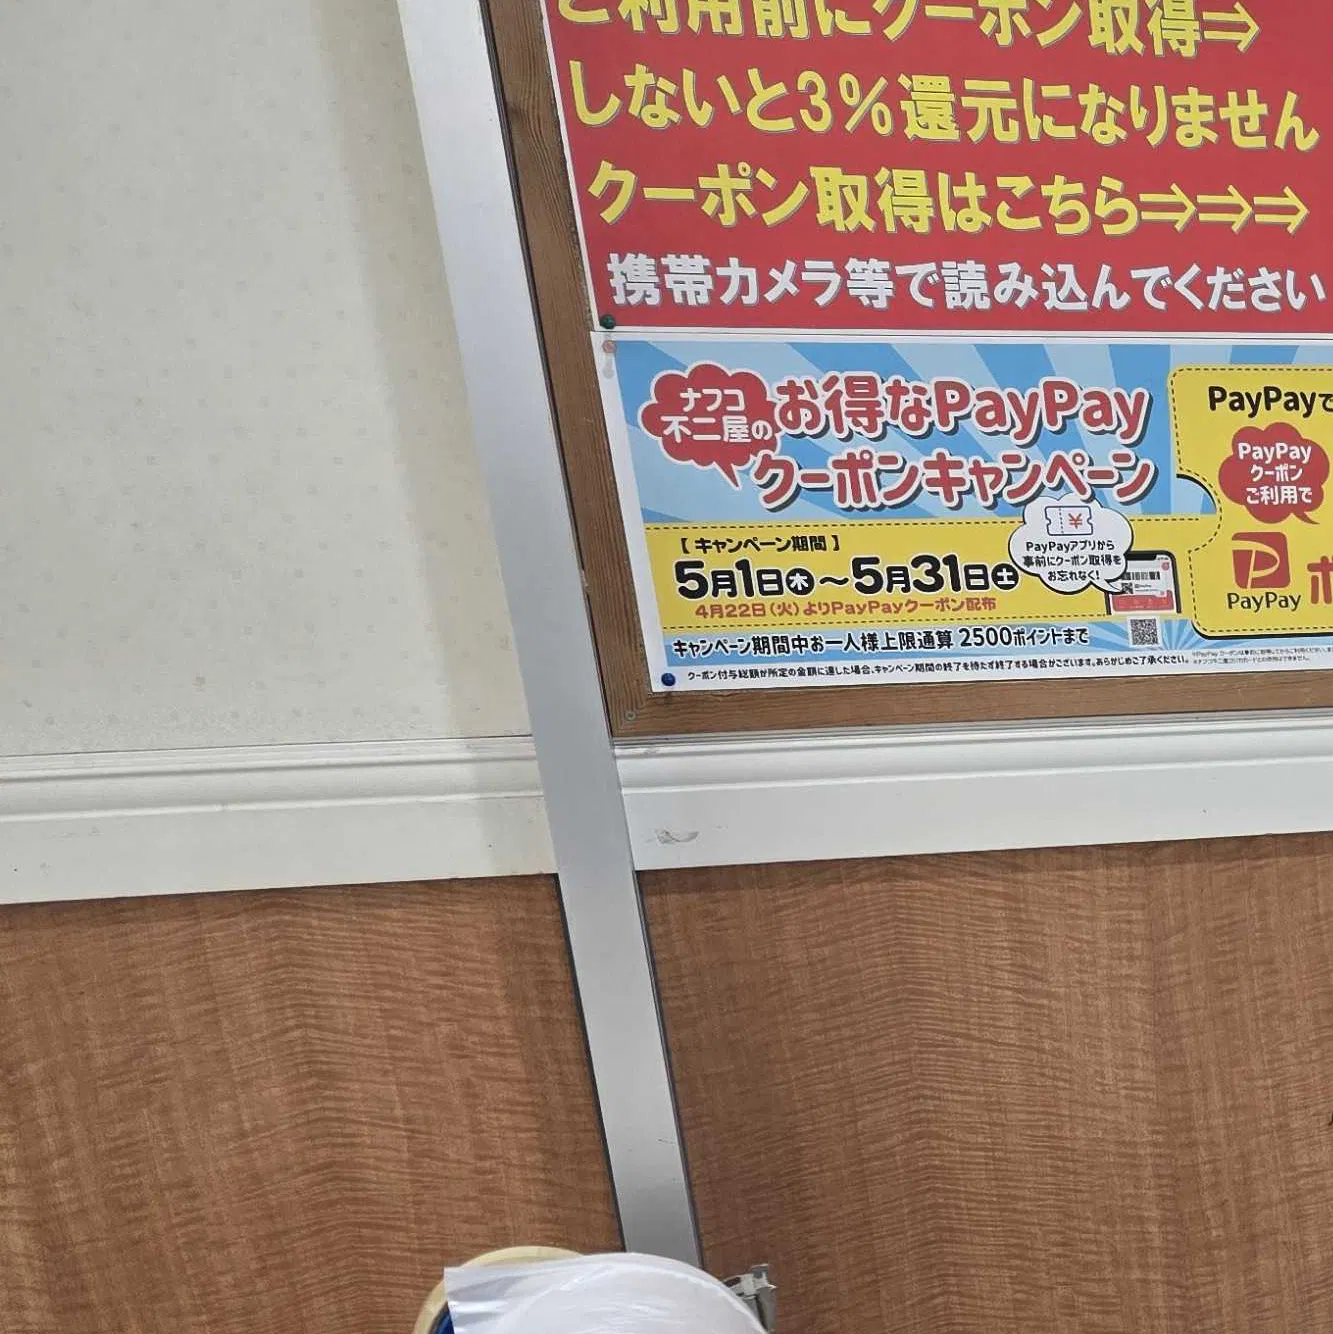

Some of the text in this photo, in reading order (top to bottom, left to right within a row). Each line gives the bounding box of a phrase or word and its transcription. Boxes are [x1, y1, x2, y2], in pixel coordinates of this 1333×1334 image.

[569, 60, 1320, 152] しないと3%還元になりません
[588, 160, 1141, 236] クーポン取得はこちら
[607, 252, 1326, 313] 携帯カメラ等で読み込んでください
[679, 388, 743, 411] ナフコ
[776, 374, 1150, 447] お得なPayPay
[1208, 385, 1333, 418] PayPayで
[662, 414, 770, 444] 不二屋の
[1238, 442, 1312, 464] PayPay
[755, 449, 1156, 508] クーポンキャンペーン
[1250, 465, 1303, 482] クーポン
[1246, 485, 1312, 506] ご利用で
[1026, 540, 1115, 553] PayPayアプリから
[1023, 554, 1122, 567] 事前にクーポン取得を
[1048, 570, 1100, 582] お忘れなく!
[1228, 592, 1301, 611] PayPay
[673, 625, 1089, 656] キャンペーン期間中お一人様上限通算 2500ポイントまで
